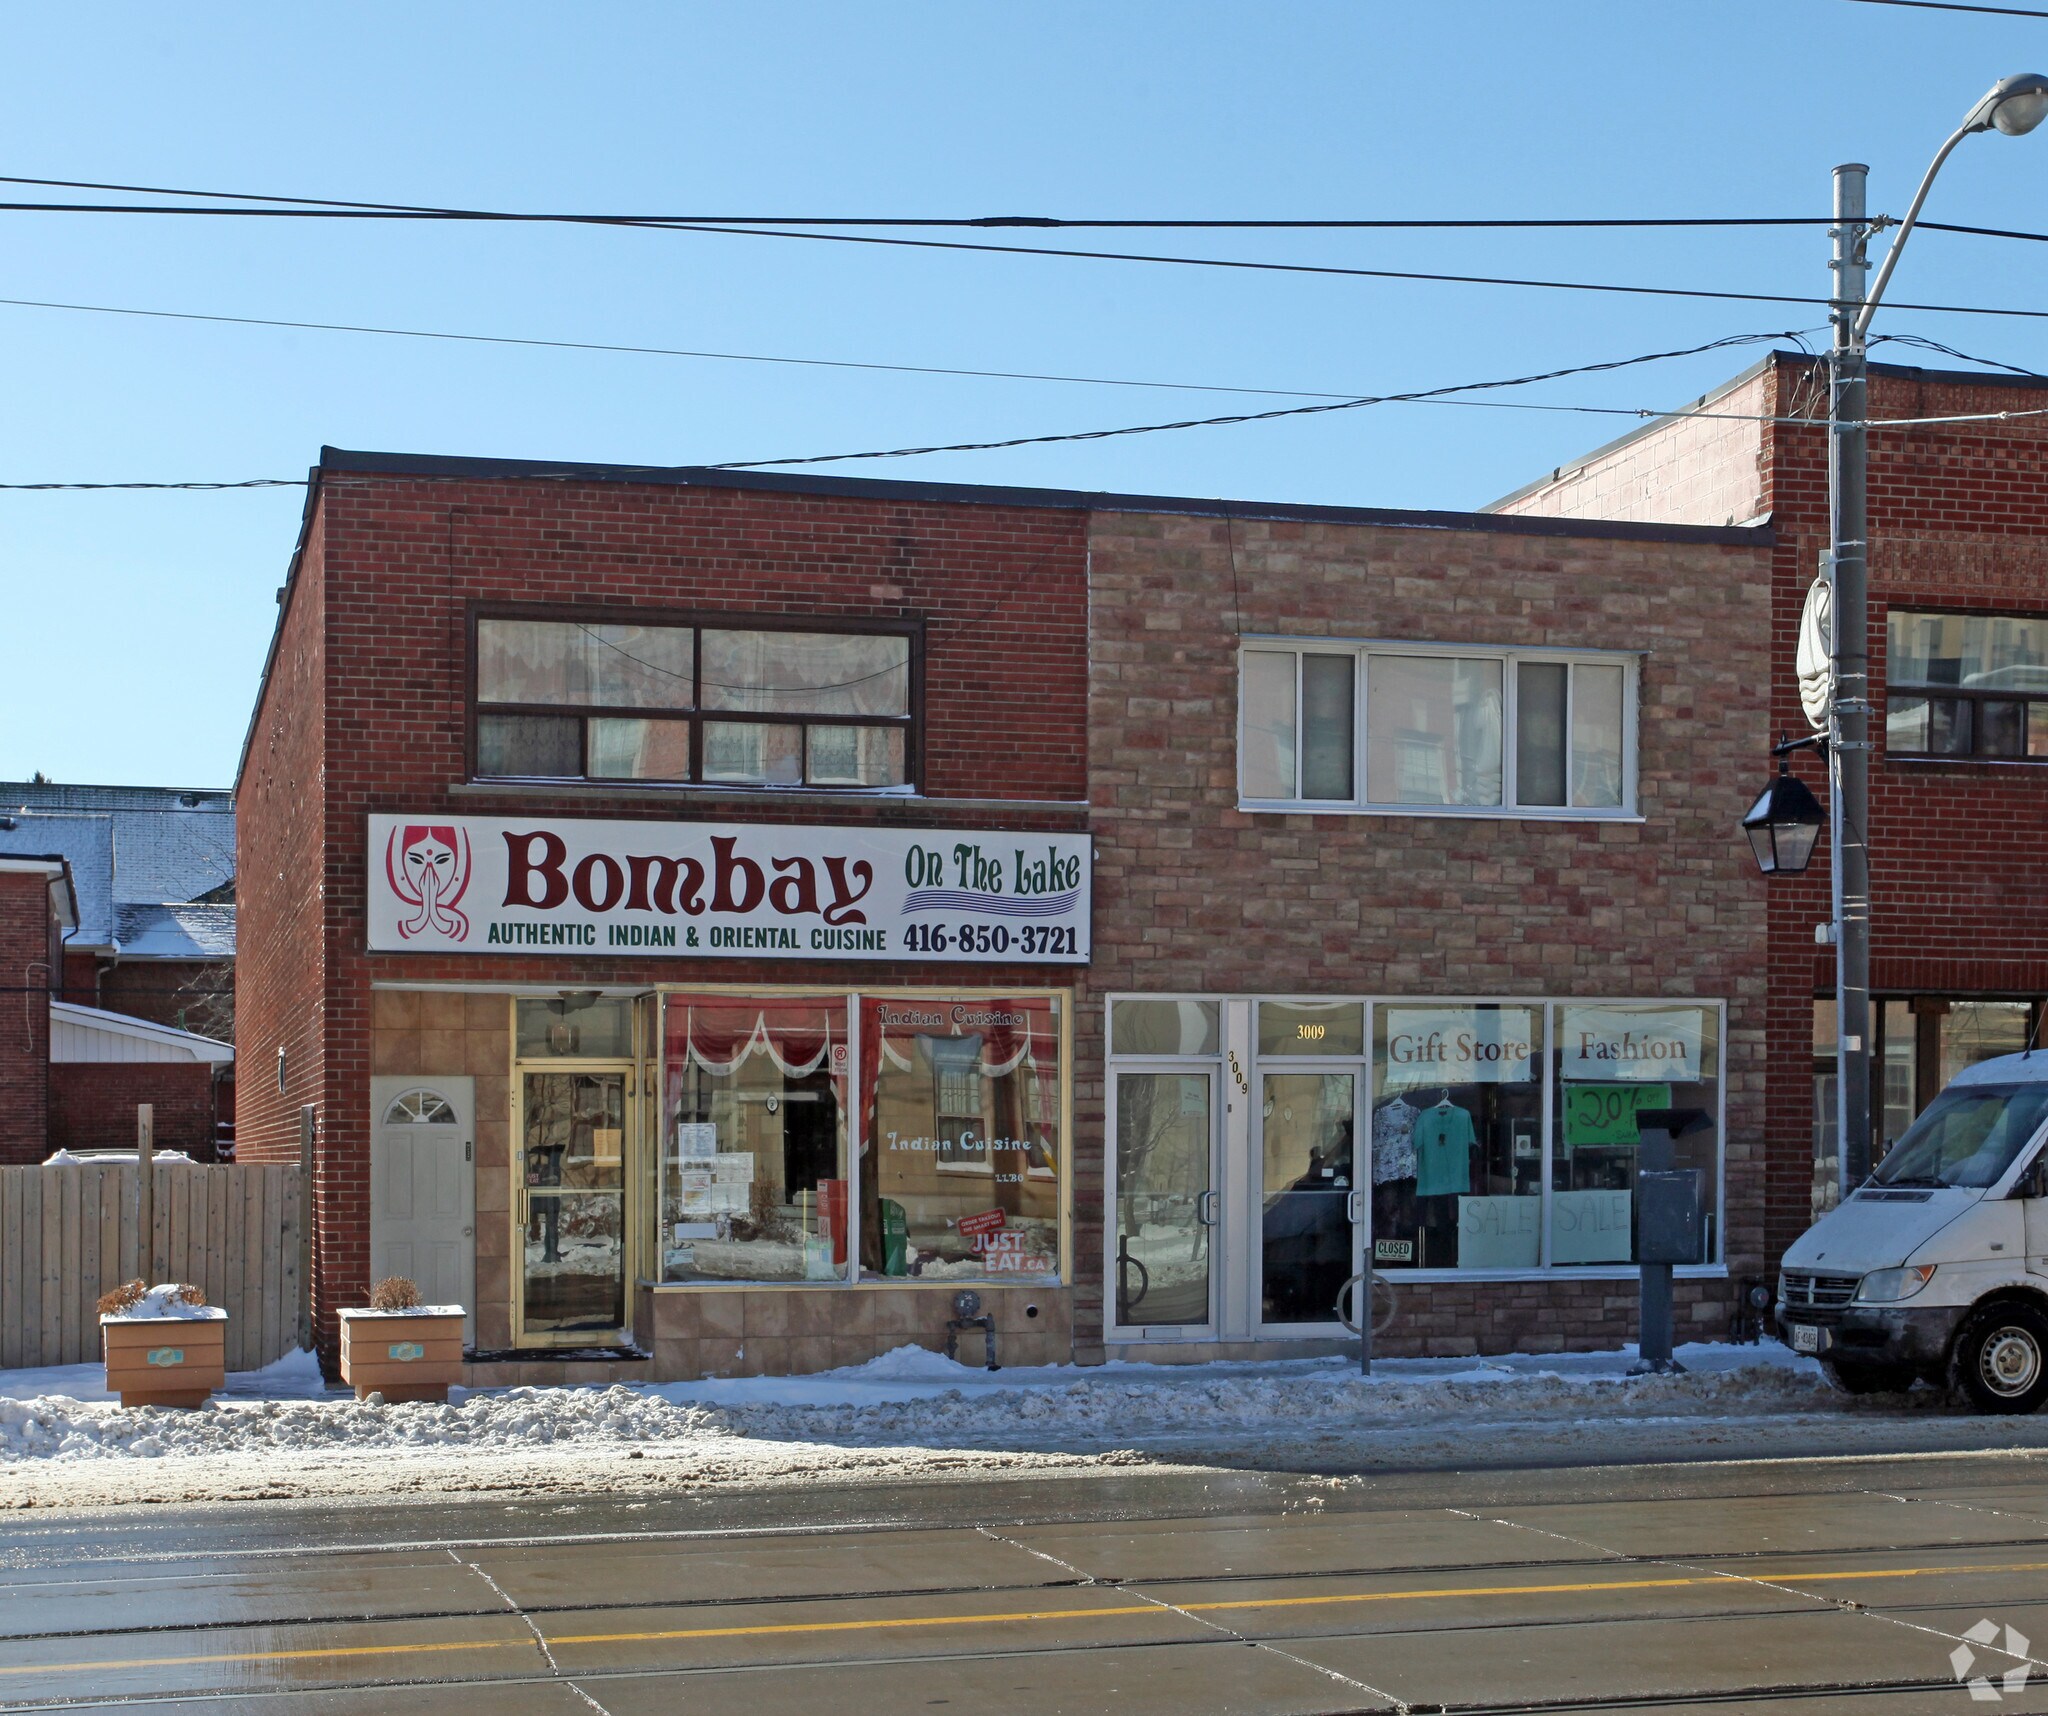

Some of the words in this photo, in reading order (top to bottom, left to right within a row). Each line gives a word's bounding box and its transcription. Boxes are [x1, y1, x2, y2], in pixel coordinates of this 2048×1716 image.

[501, 830, 873, 925] Bombay
[904, 845, 943, 888] On
[954, 843, 1003, 893] The
[1014, 845, 1081, 894] Lake
[487, 922, 596, 946] AUTHENTIC
[608, 925, 676, 947] INDIAN
[685, 926, 700, 948] &
[709, 926, 801, 949] ORIENTAL
[810, 928, 887, 951] CUISINE
[902, 924, 1078, 955] 416-850-3721
[877, 1005, 943, 1025] Indian
[950, 1004, 1024, 1025] Cuisine
[1296, 1024, 1325, 1040] 3009
[1578, 1031, 1688, 1060] Fashion
[1389, 1032, 1448, 1063] Gift
[1456, 1033, 1529, 1061] Store
[1228, 1050, 1248, 1094] 3009
[1579, 1087, 1642, 1129] 20%
[886, 1131, 952, 1151] Indian
[960, 1131, 1032, 1151] Cuisine
[1465, 1200, 1534, 1236] SALE
[1557, 1195, 1628, 1233] SALE
[973, 1232, 1025, 1252] JUST
[1378, 1241, 1410, 1255] CLOSED
[985, 1252, 1045, 1271] EAT.CA
